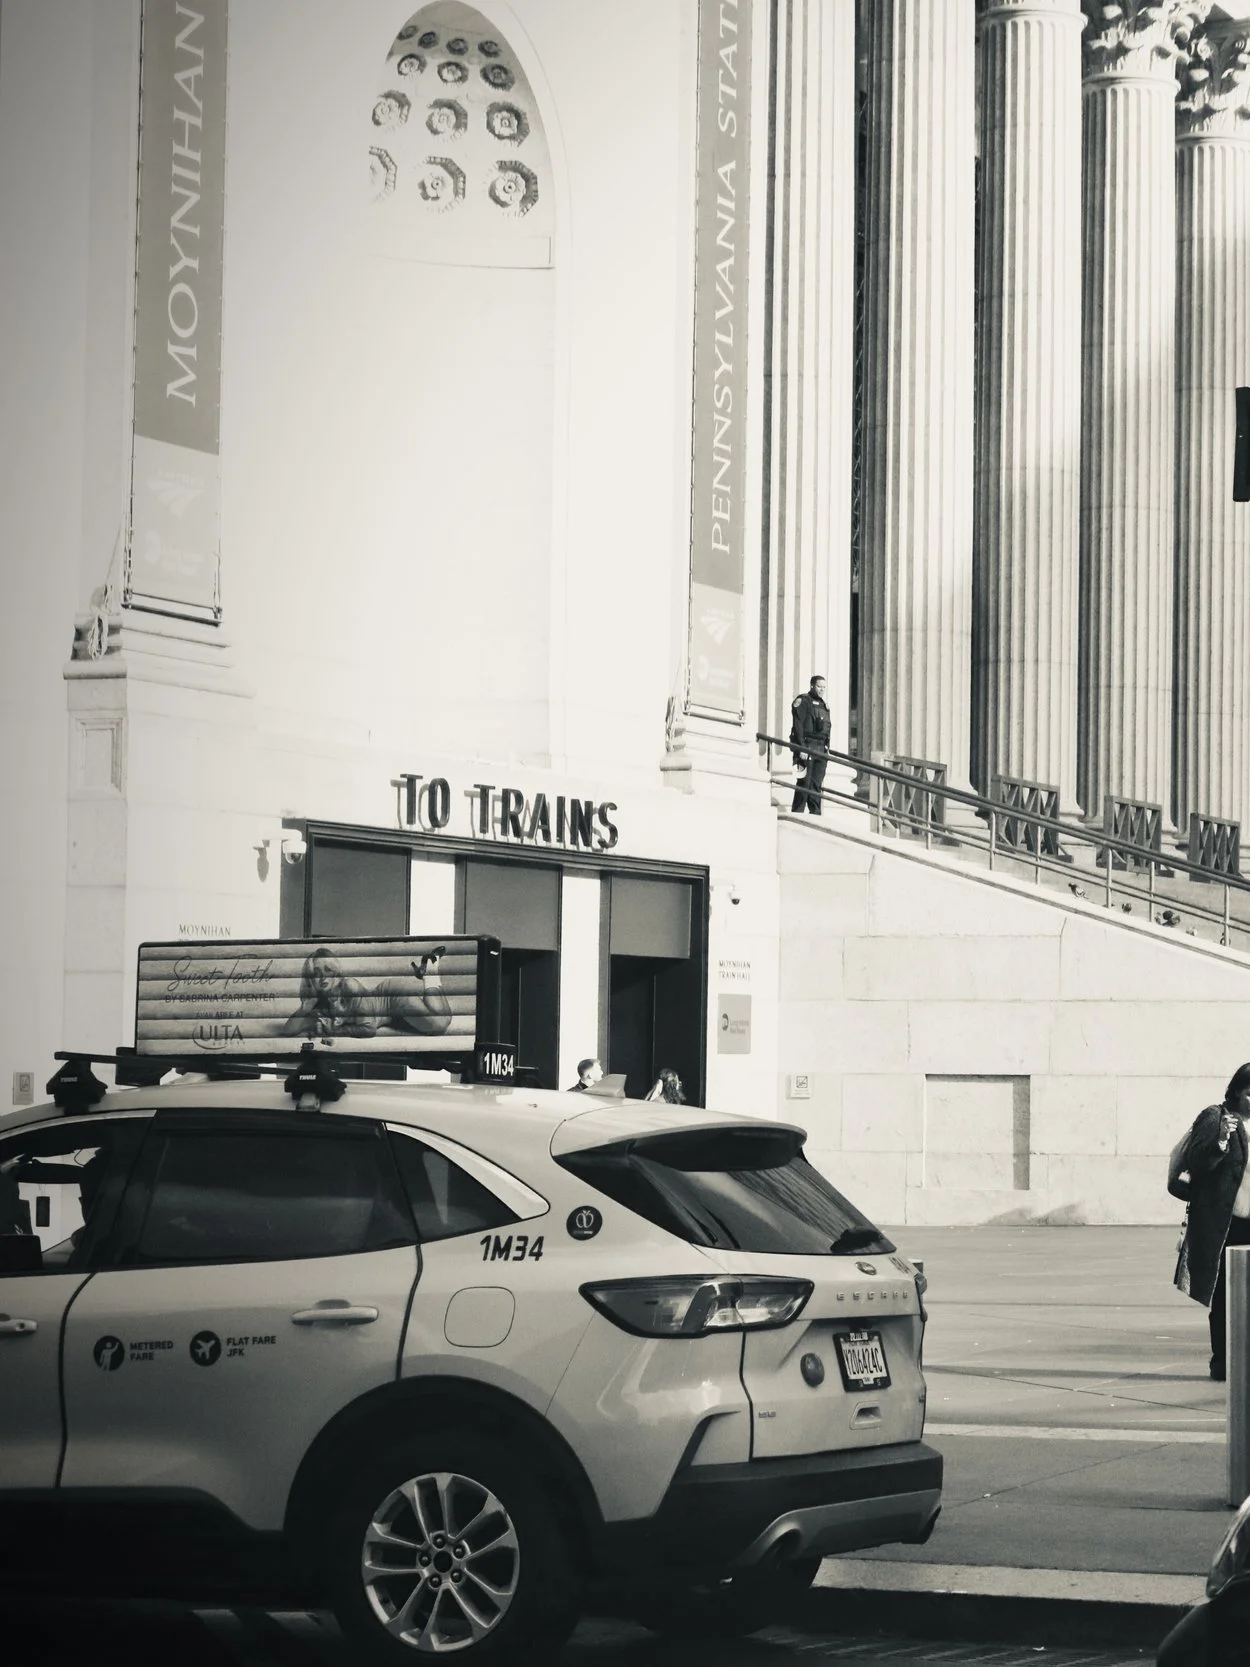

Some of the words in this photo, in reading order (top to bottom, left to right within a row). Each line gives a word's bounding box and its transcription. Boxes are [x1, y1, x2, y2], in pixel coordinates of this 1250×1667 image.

[166, 2, 205, 408] MOYNIHAN
[711, 158, 738, 554] PENNSYLVANIA
[400, 774, 450, 829] TO
[473, 784, 618, 850] TRAINS
[178, 923, 232, 937] MOYNIHAN
[222, 953, 276, 990] Tooth
[165, 995, 177, 1003] BY
[179, 994, 219, 1003] SABRINA
[221, 992, 275, 1003] CARPENTER
[199, 1025, 244, 1041] ULTA
[484, 1052, 515, 1077] 1M34
[480, 1235, 544, 1261] 1M34
[130, 1340, 173, 1350] METERED
[226, 1337, 249, 1346] FLAT
[252, 1335, 277, 1345] FARE
[130, 1352, 154, 1361] FARE
[227, 1348, 244, 1357] JFK
